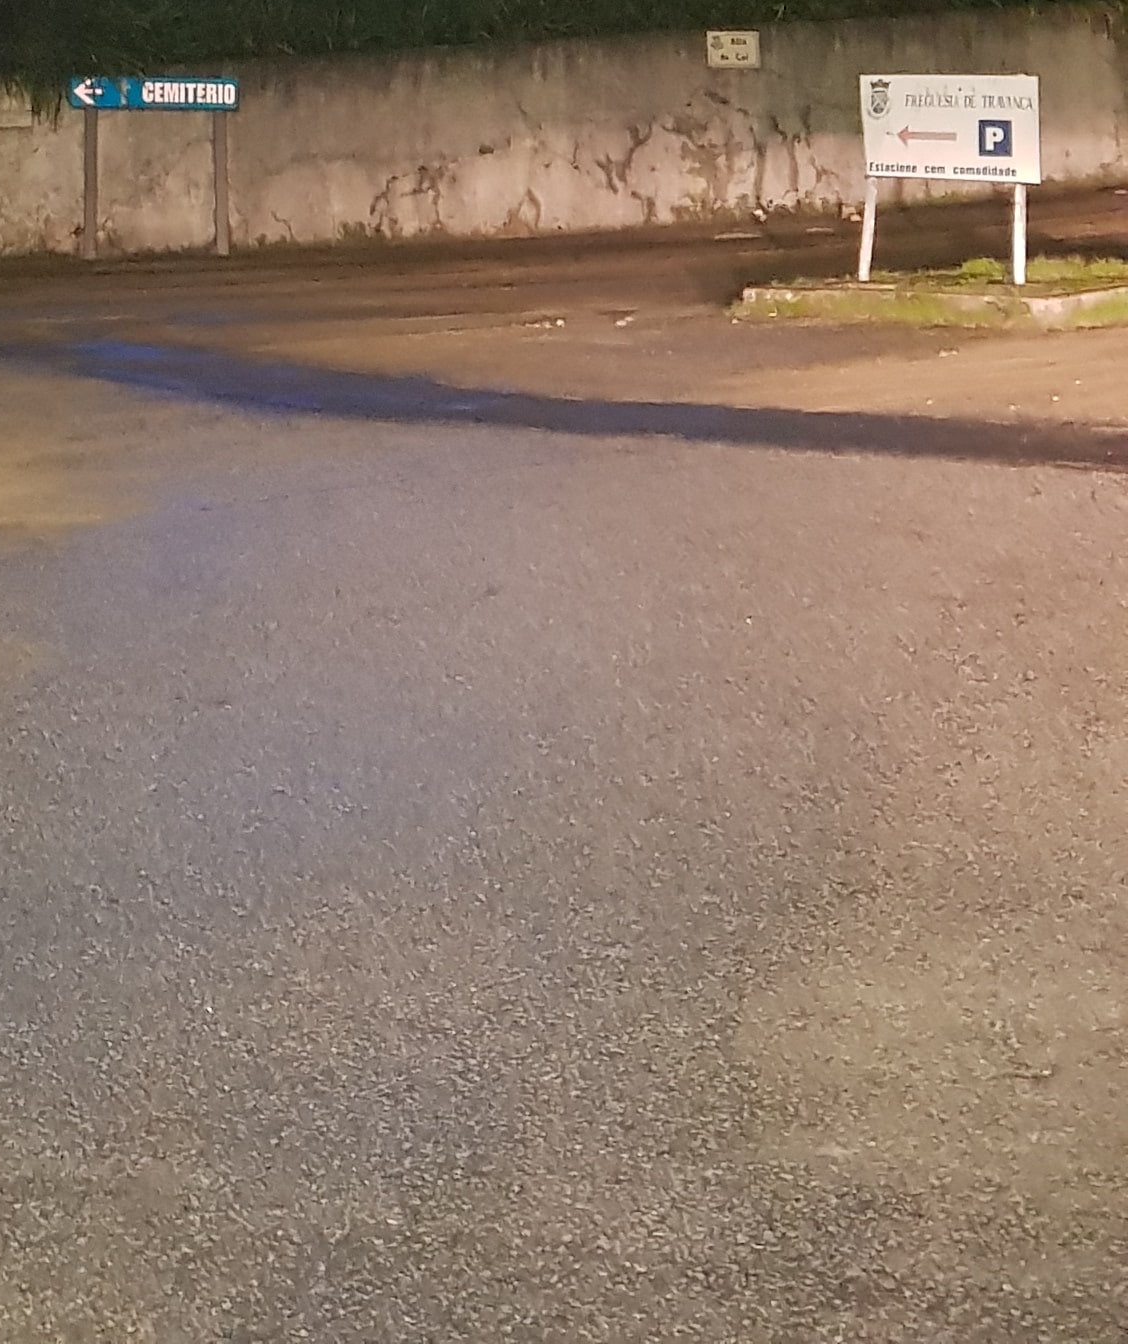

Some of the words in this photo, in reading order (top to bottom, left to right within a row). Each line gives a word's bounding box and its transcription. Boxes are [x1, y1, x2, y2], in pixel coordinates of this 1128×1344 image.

[141, 81, 236, 104] CEMITERIO
[904, 93, 959, 107] FREGUESIA
[964, 94, 976, 108] DE
[984, 126, 1005, 151] P
[953, 165, 1017, 177] comodidade
